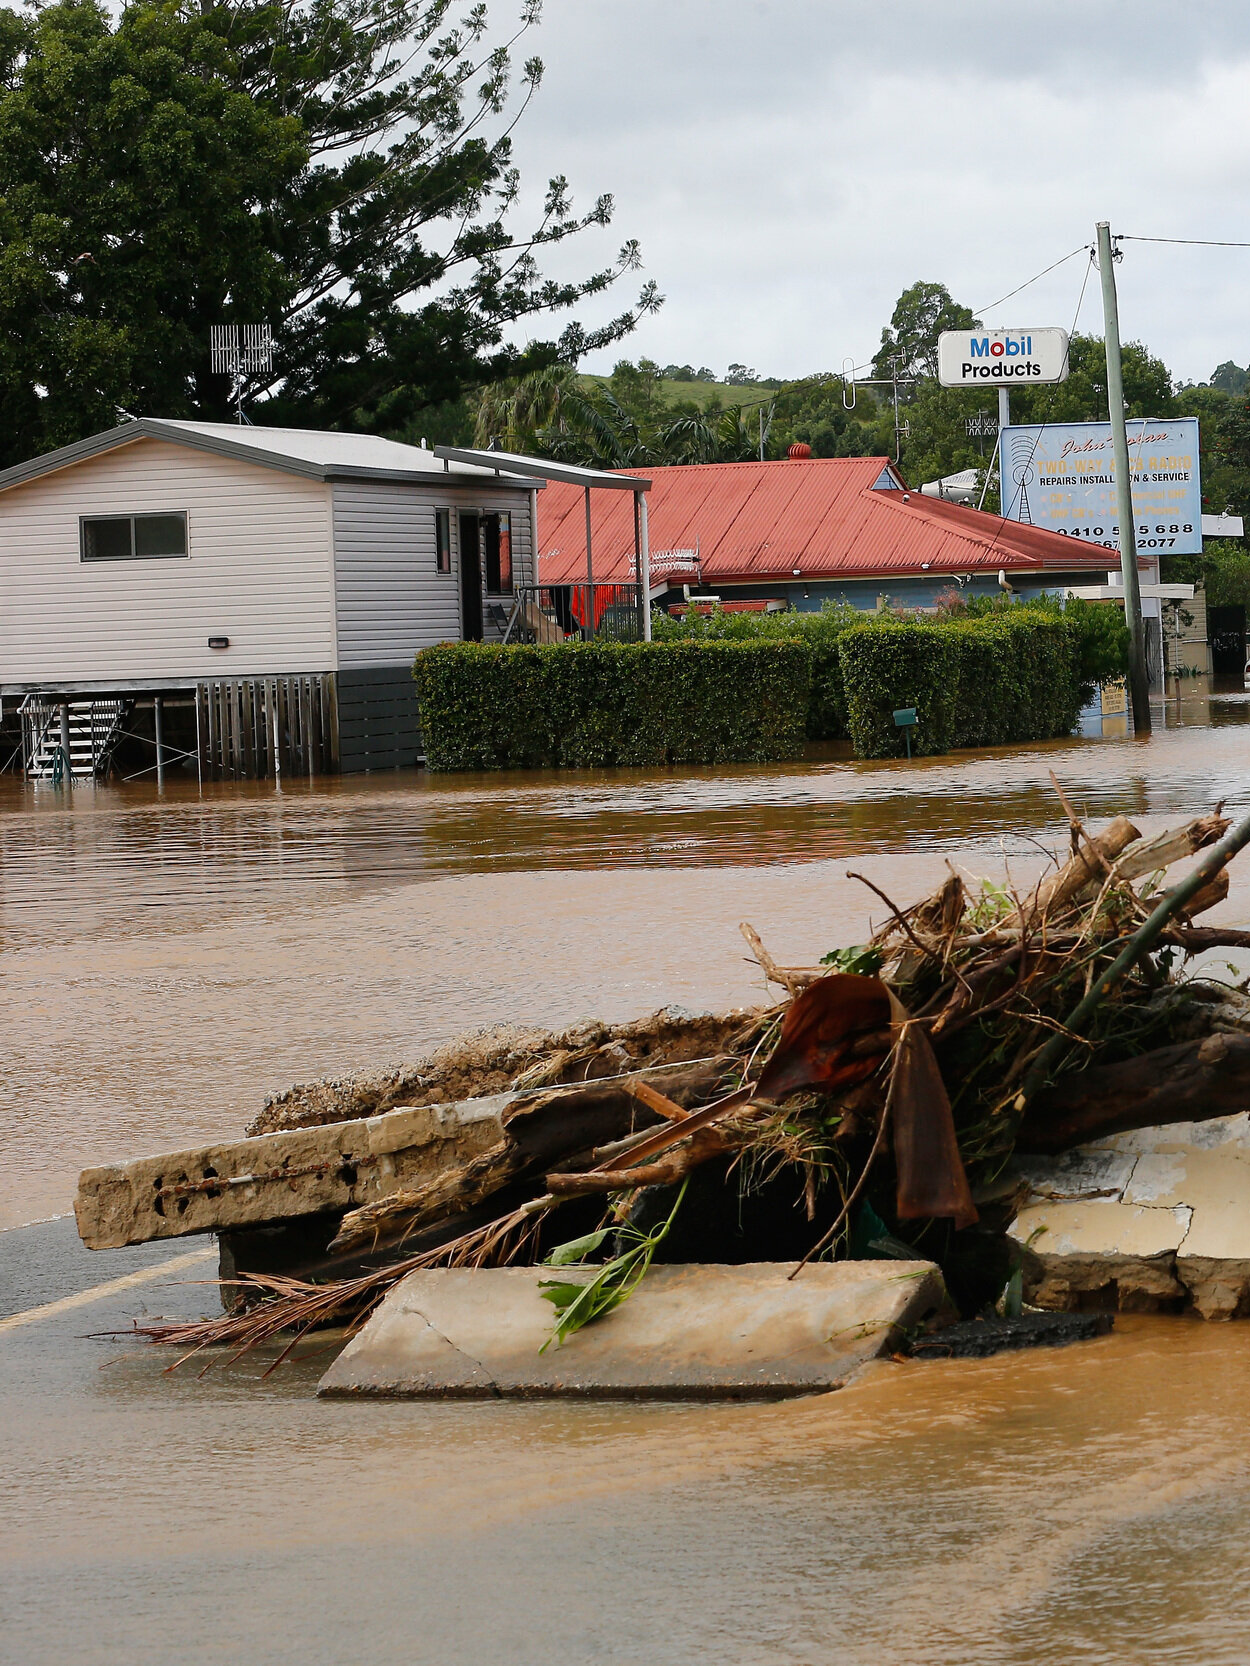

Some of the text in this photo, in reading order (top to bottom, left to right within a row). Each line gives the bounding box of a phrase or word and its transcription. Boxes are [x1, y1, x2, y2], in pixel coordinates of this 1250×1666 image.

[970, 335, 1032, 358] Mobil
[962, 361, 1041, 378] Products
[1061, 438, 1105, 458] John
[1148, 455, 1192, 471] RADIO
[1040, 476, 1077, 486] REPAIRS
[1142, 474, 1149, 482] &
[1152, 472, 1189, 482] SERVICE
[1112, 525, 1149, 536] 55
[1155, 524, 1193, 534] 688
[1137, 538, 1176, 548] 2077
